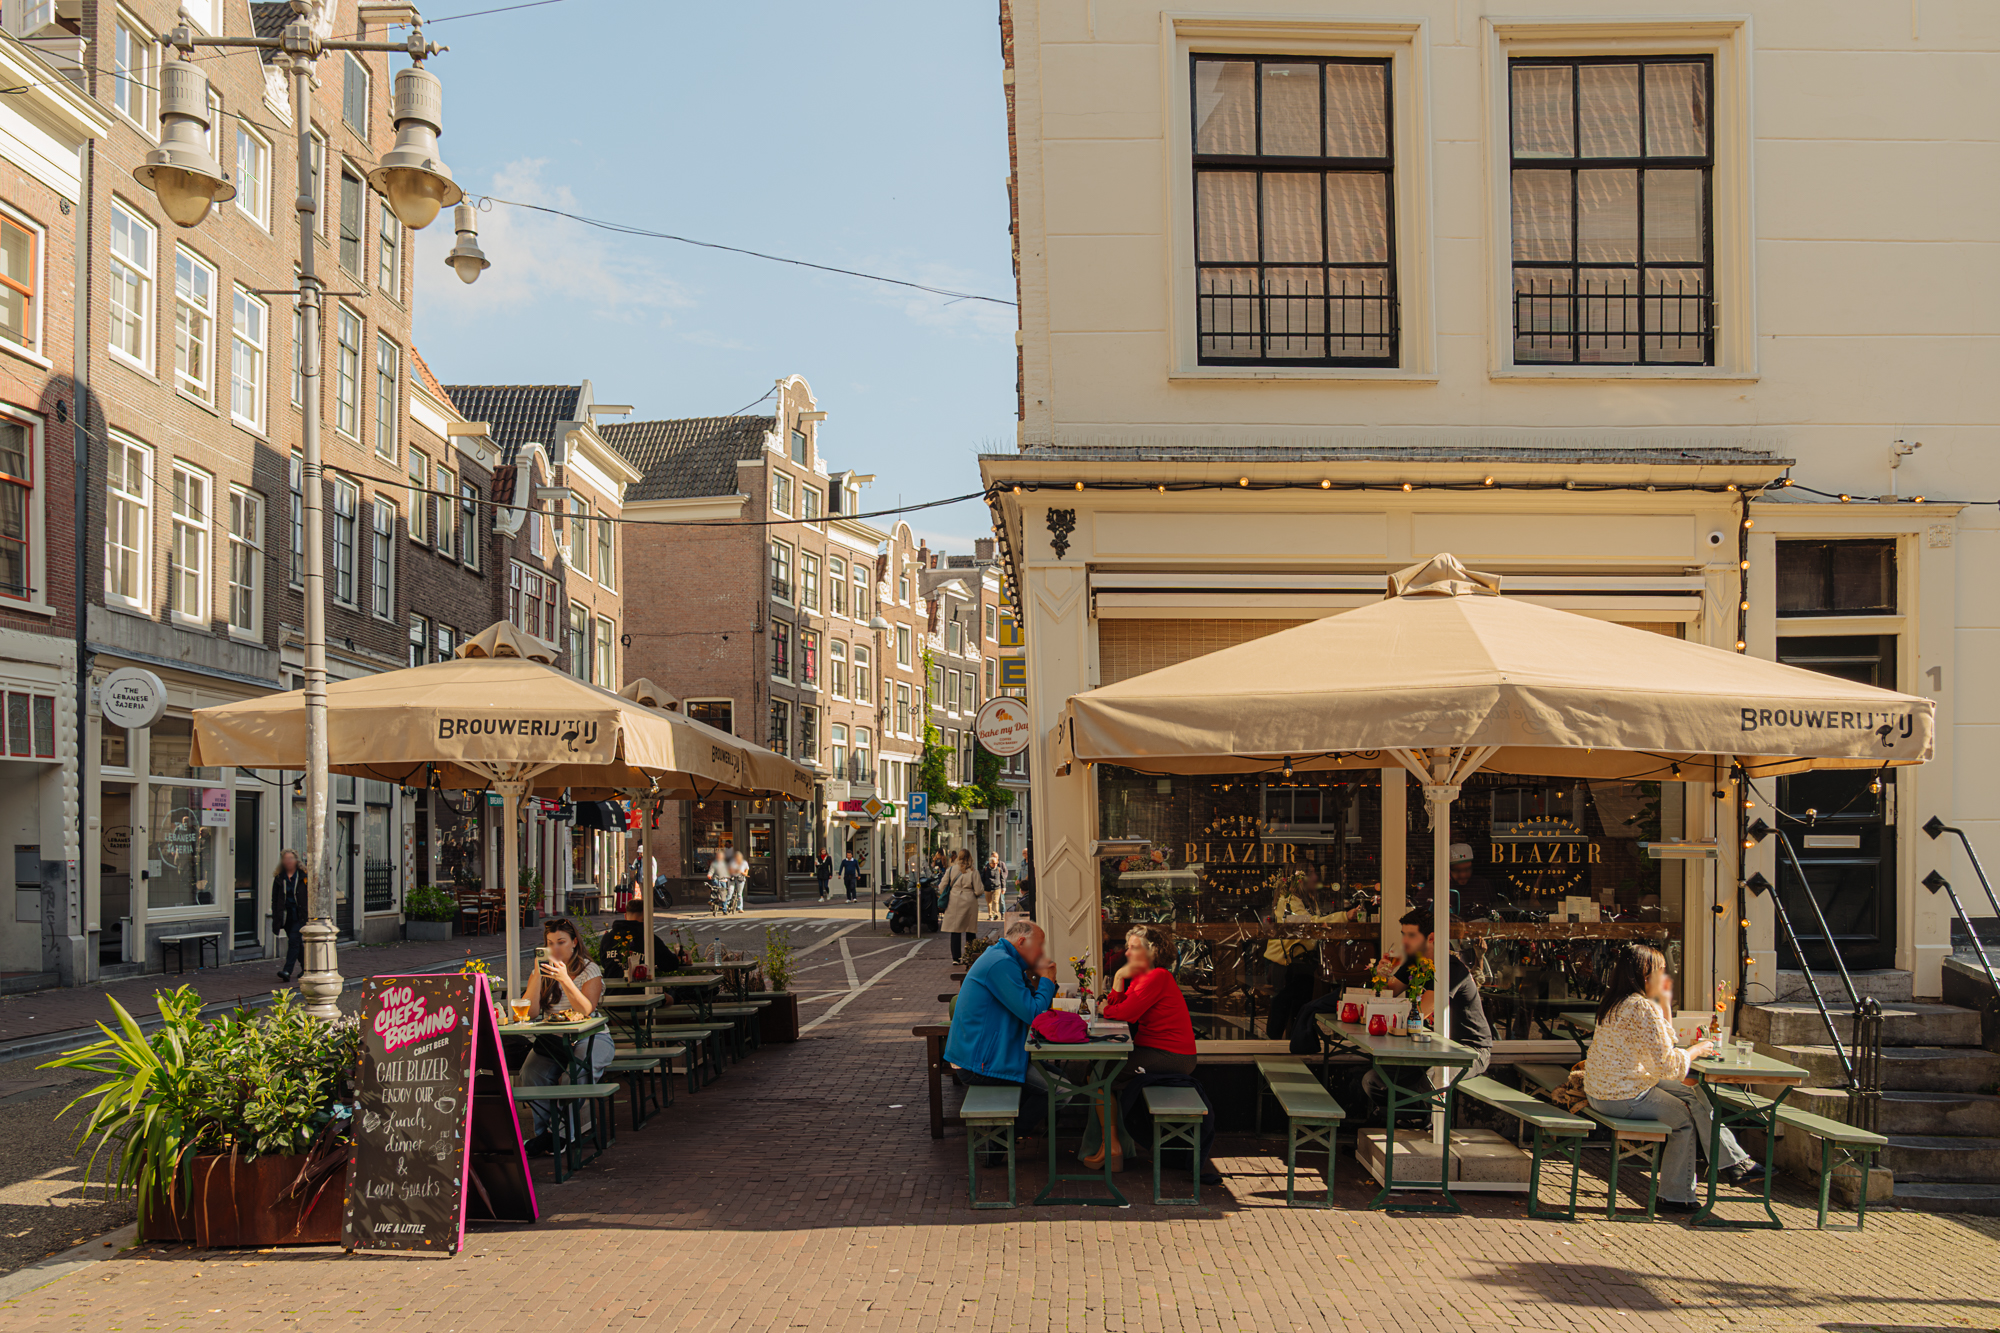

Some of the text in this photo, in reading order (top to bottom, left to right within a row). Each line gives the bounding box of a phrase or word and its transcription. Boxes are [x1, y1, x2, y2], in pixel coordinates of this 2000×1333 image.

[1925, 666, 1942, 691] 1
[112, 693, 149, 702] LEBANESE
[115, 700, 146, 710] SAJERIA
[438, 718, 560, 739] BROUWERIJ
[584, 721, 597, 744] IJ
[979, 728, 999, 739] Bake
[1000, 726, 1013, 735] my
[1741, 708, 1873, 731] BROUWERIJ
[1899, 713, 1913, 738] IJ
[912, 795, 923, 810] P
[1204, 815, 1276, 835] BRASSERIE
[1222, 829, 1255, 837] CAFÉ
[1510, 815, 1581, 835] BRASSERIE
[1528, 829, 1560, 837] CAFÉ
[165, 832, 196, 842] LEBANESE
[1184, 842, 1297, 864] BLAZER
[1490, 842, 1602, 864] BLAZER
[1202, 874, 1277, 895] AMSTERDAM
[1508, 873, 1582, 895] AMSTERDAM
[380, 986, 412, 1009] TWO
[374, 996, 425, 1033] CHEFS
[382, 1005, 456, 1050] BREWING
[413, 1037, 449, 1057] CRAFT BEER
[376, 1056, 450, 1082] CAFÉ BLAZER
[382, 1086, 434, 1104] ENJOY OUR
[384, 1133, 426, 1153] dinner
[396, 1156, 408, 1176] &
[373, 1222, 426, 1234] LIVE A LITTLE
